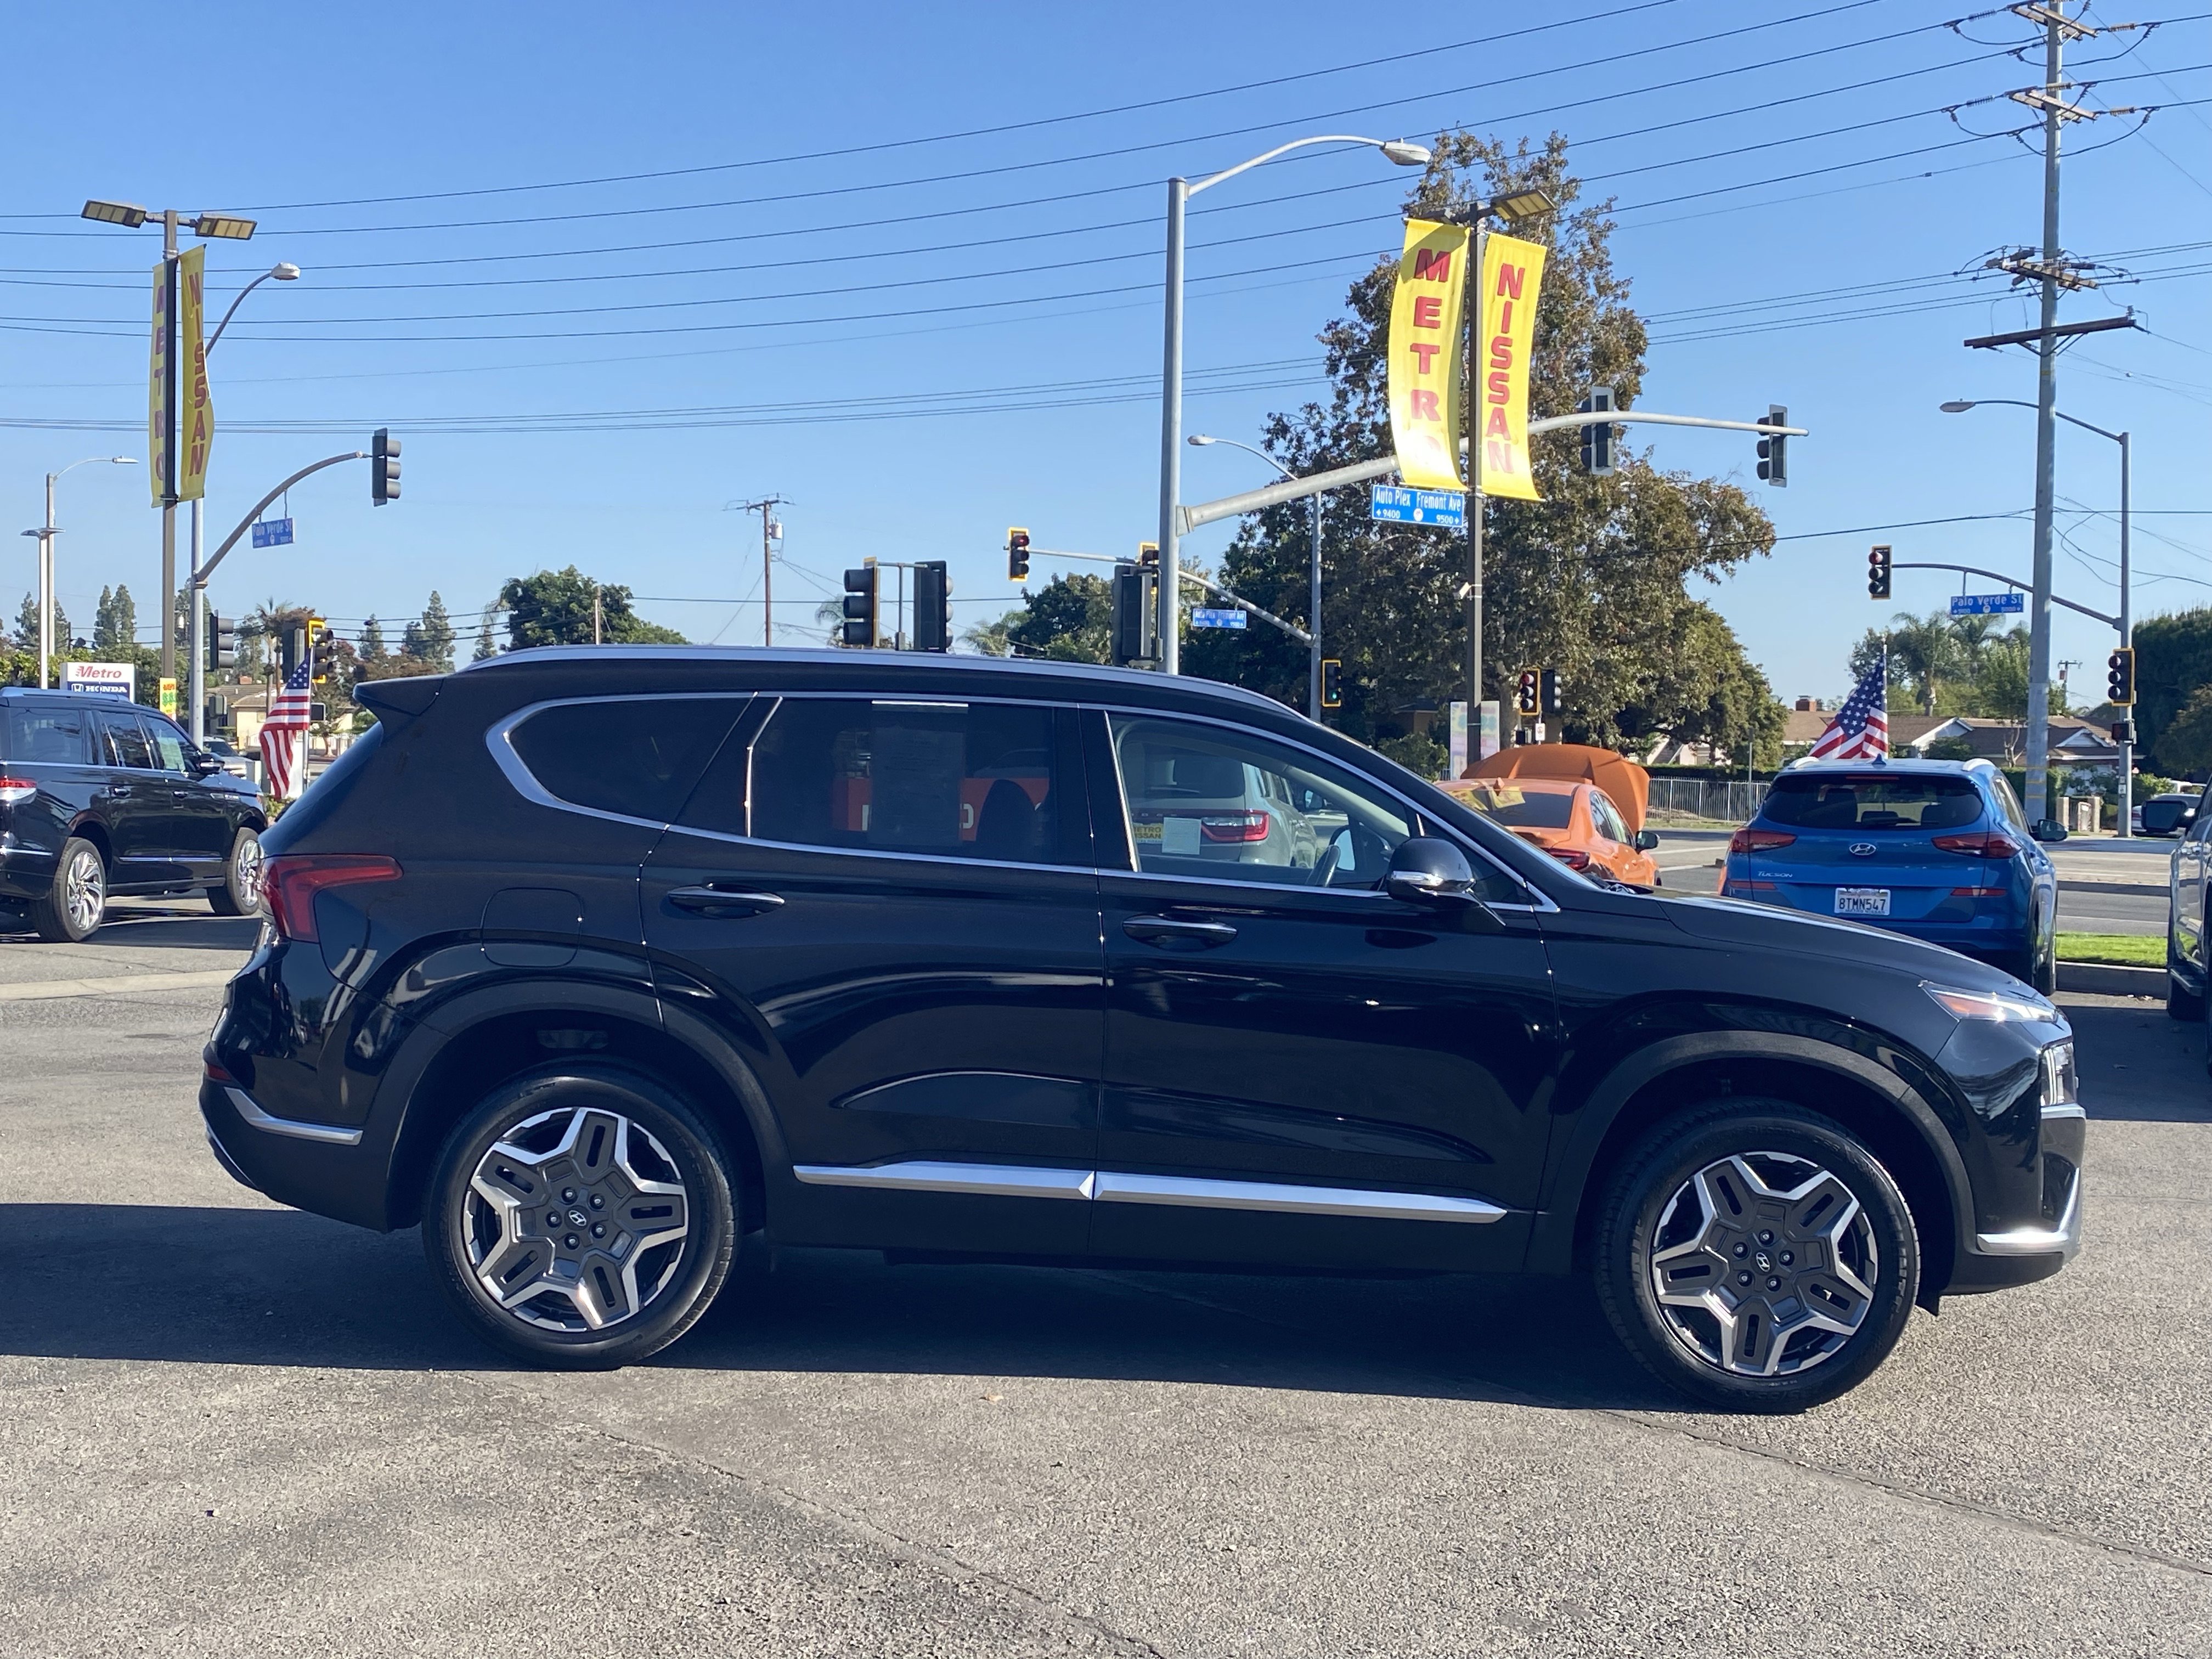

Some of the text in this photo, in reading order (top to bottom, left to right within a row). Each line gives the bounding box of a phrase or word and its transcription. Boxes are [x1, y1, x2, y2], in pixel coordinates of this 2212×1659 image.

[189, 272, 207, 476] NISSAN
[1486, 263, 1525, 473] NISSAN
[1376, 488, 1461, 512] Auto Plex Fremont Ave
[1383, 509, 1454, 524] 9400 9500
[1952, 595, 2022, 606] Palo Verde St
[76, 665, 122, 678] Metro
[1839, 898, 1886, 910] 8TMN547
